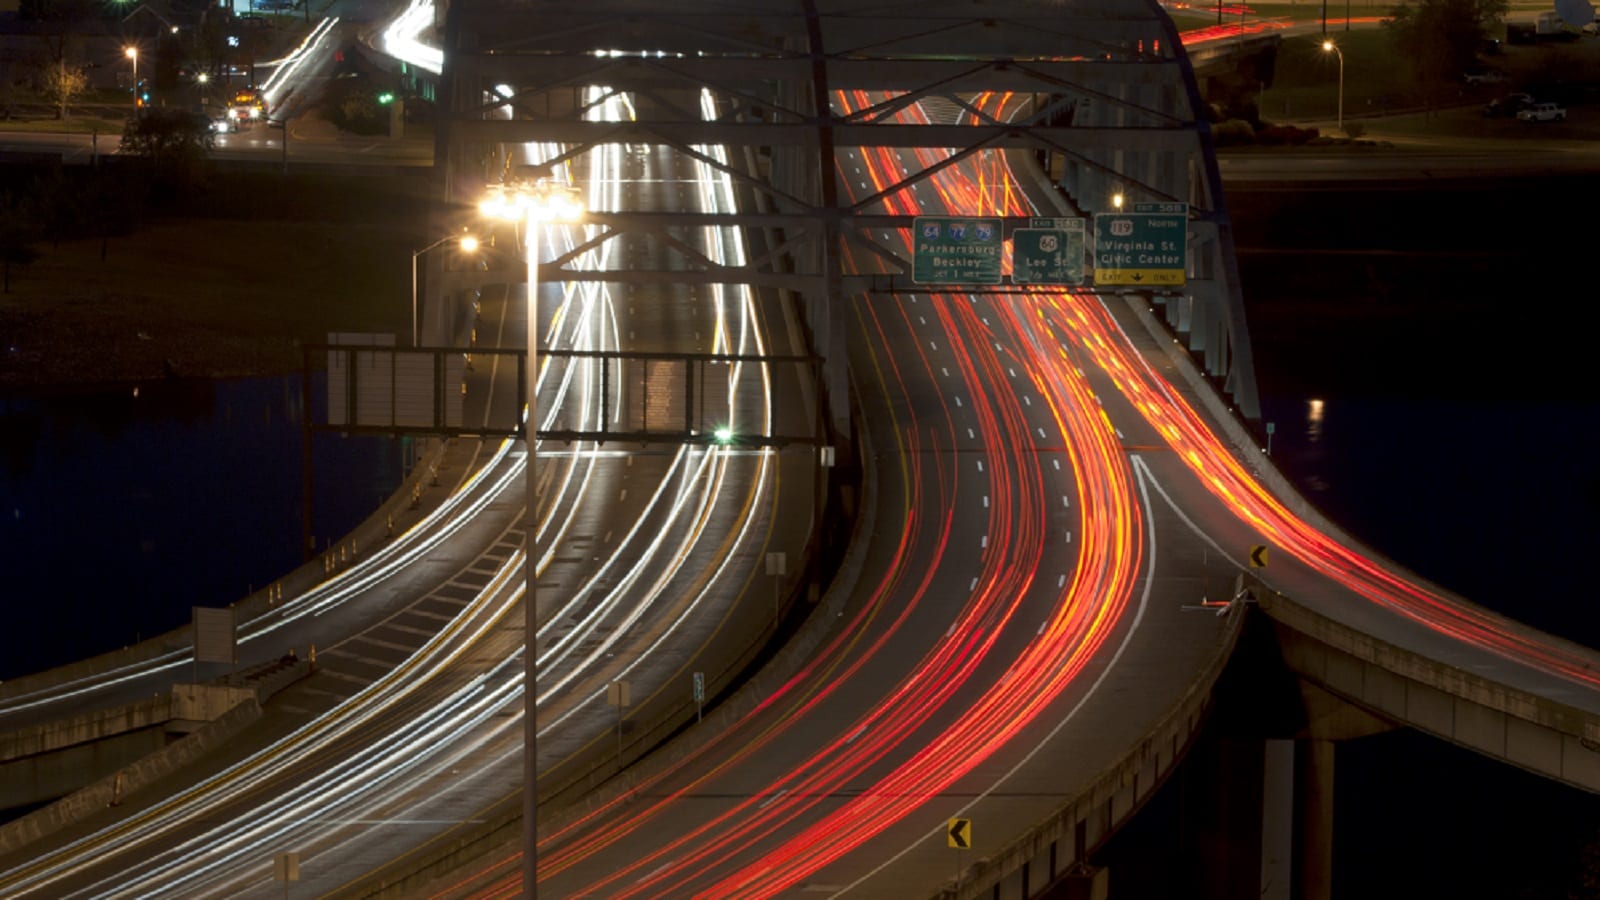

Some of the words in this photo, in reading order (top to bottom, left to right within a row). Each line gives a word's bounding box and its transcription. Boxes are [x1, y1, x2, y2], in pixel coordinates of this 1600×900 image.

[923, 226, 940, 238] 64
[951, 226, 966, 238] 77
[976, 226, 992, 238] 79
[1113, 222, 1131, 233] 119
[920, 243, 995, 256] Parkersburg
[1041, 238, 1055, 249] 60
[1104, 240, 1155, 253] Virginia
[1161, 240, 1177, 251] St.
[933, 256, 982, 268] Beckley
[1026, 257, 1047, 267] Lee
[1101, 254, 1132, 264] Civic
[1138, 254, 1180, 264] Center
[1102, 273, 1121, 281] EXIT
[1153, 272, 1177, 281] ONLY
